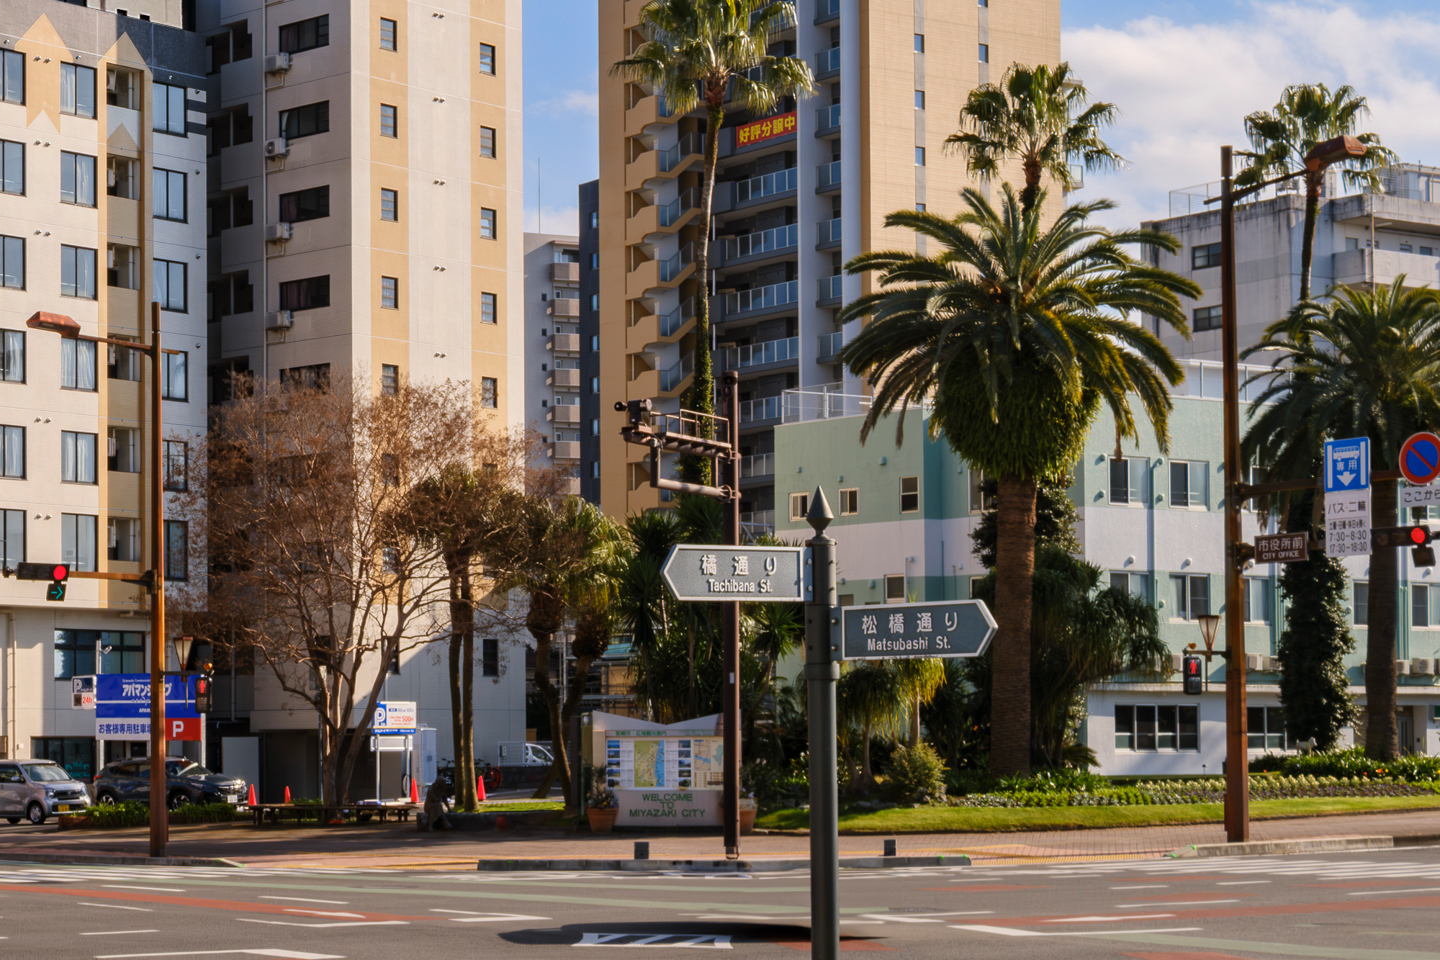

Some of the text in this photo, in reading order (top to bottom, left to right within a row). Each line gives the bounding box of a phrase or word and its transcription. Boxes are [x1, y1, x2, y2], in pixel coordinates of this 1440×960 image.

[739, 115, 796, 143] 好評分譲中
[1336, 459, 1358, 472] 専用
[1403, 489, 1440, 503] ここから
[1258, 538, 1303, 552] 市役所前
[1262, 550, 1300, 560] CITY OFFICE
[701, 554, 778, 577] 橘通り
[708, 578, 773, 593] Tachibana St.
[862, 611, 958, 635] 松橋通り
[867, 635, 951, 651] Matsubashi St.
[122, 683, 173, 697] アパマンシプ
[82, 696, 93, 704] 24h
[172, 721, 184, 738] P
[642, 793, 693, 801] WELCOME
[660, 801, 674, 809] TO
[629, 809, 705, 817] MIYAZAKI CITY
